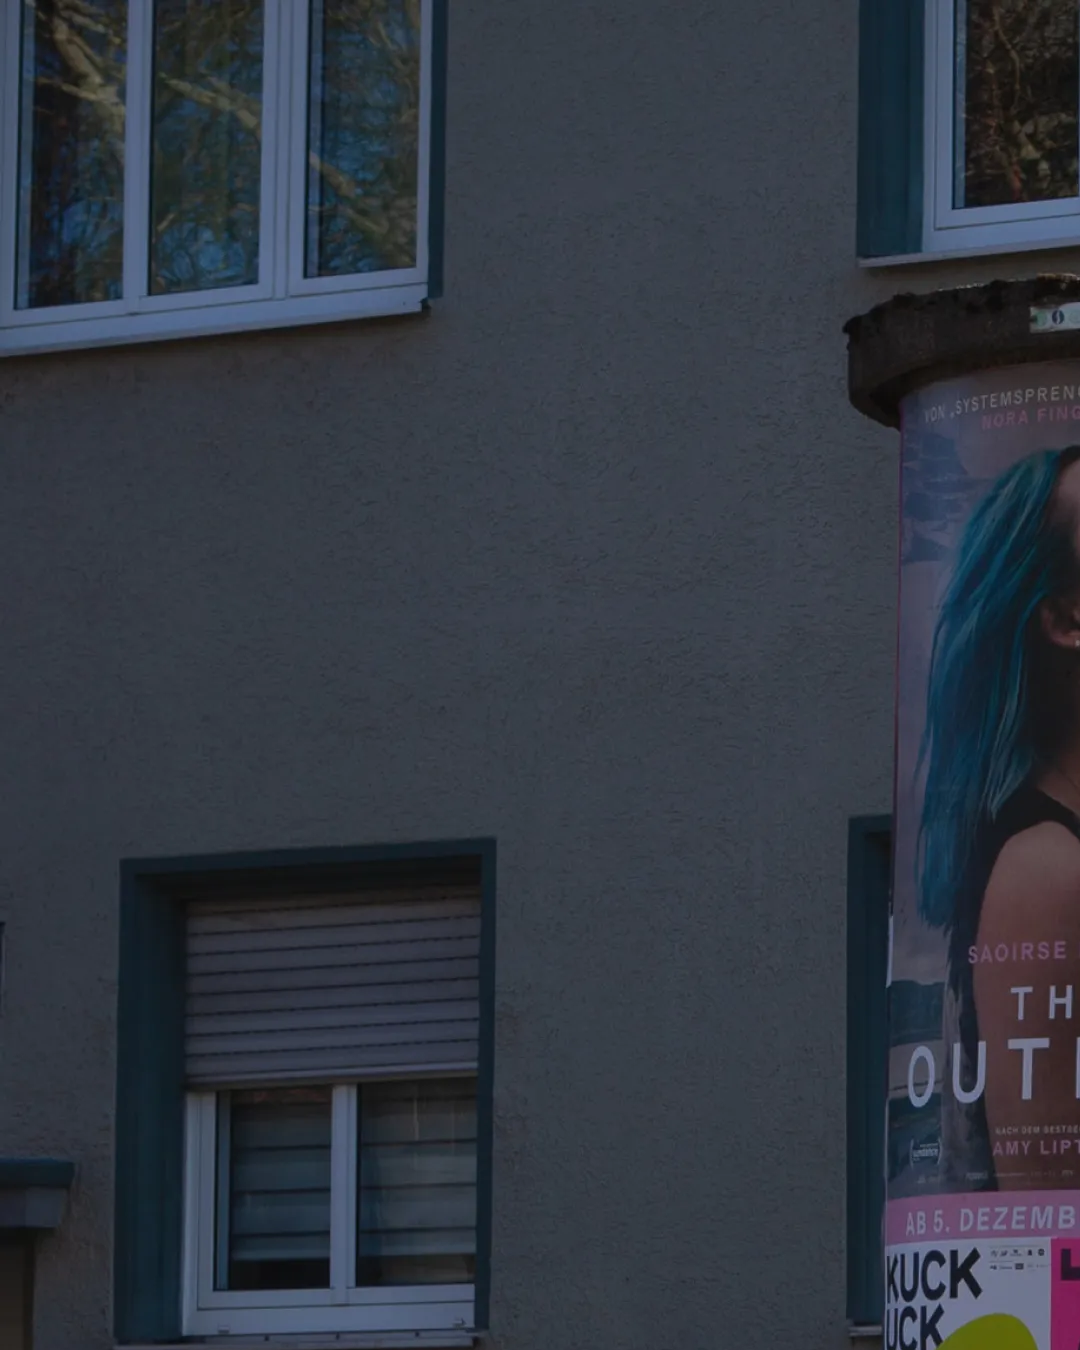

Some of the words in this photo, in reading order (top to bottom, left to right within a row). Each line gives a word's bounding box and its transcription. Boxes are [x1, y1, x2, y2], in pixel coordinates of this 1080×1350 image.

[982, 411, 1028, 430] NORA
[968, 941, 1067, 964] SAOIRSE
[993, 1140, 1032, 1156] AMY
[905, 1210, 927, 1237] AB
[933, 1209, 950, 1233] 5.
[886, 1247, 983, 1303] KUCK
